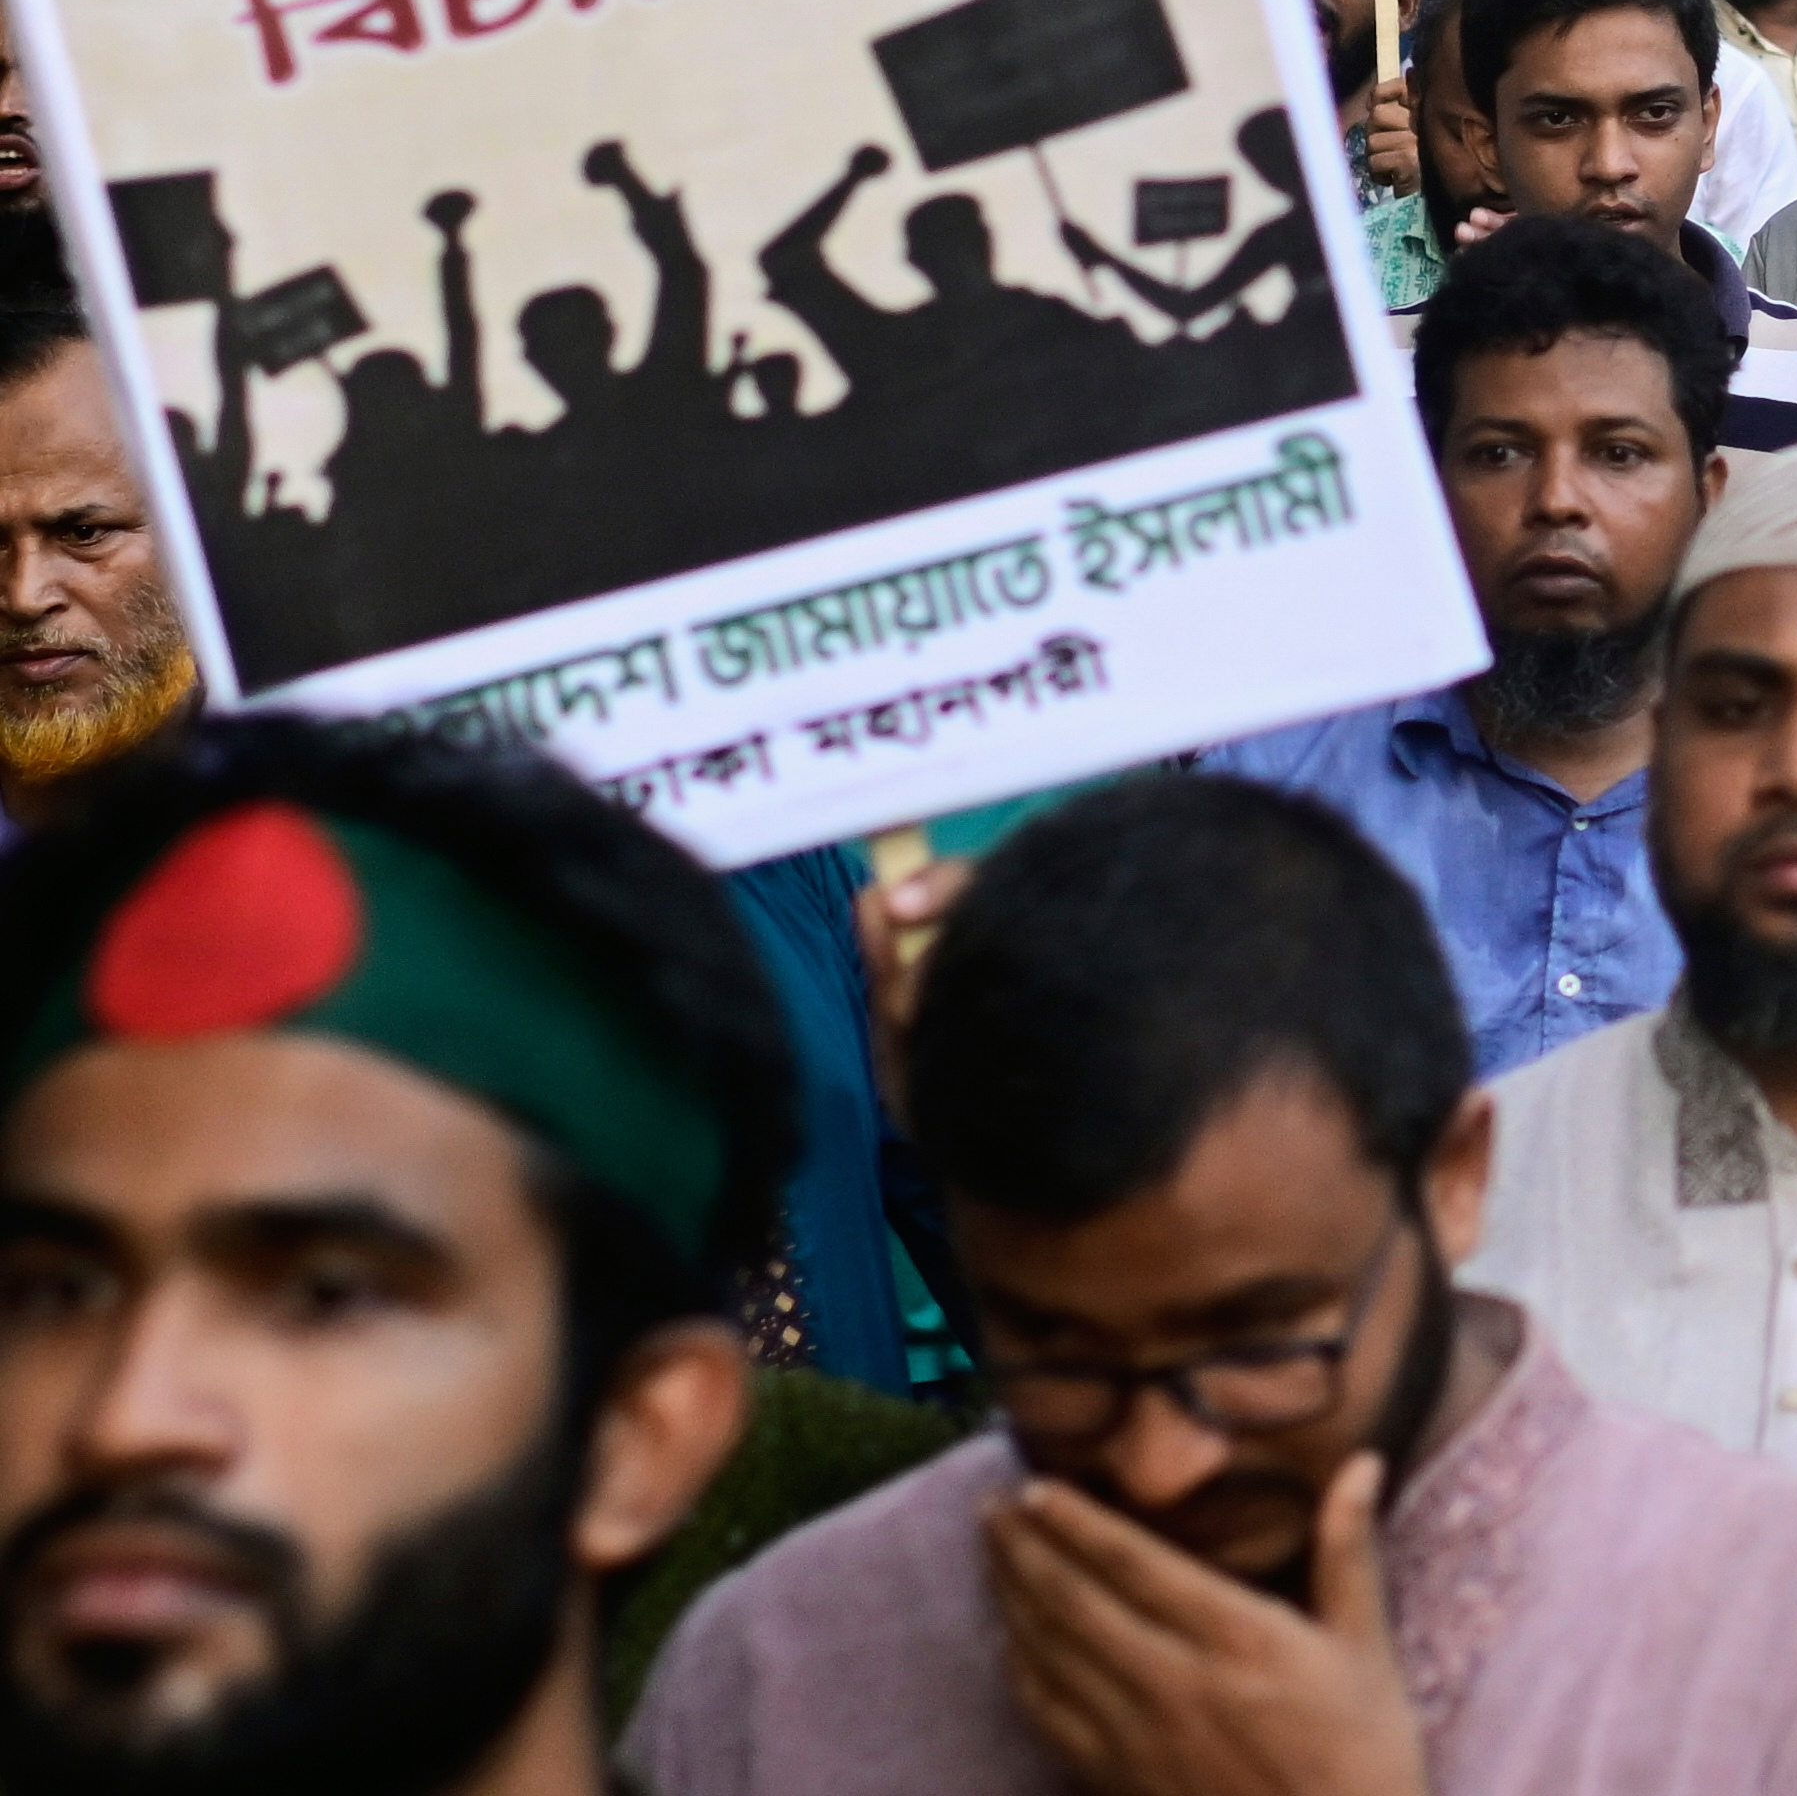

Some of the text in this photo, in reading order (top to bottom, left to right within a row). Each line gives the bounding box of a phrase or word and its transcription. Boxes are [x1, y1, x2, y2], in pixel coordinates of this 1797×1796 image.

[691, 537, 1056, 697] জামায়াতে
[1062, 430, 1360, 598] ইসলামী
[798, 629, 1113, 766] মহানগরী
